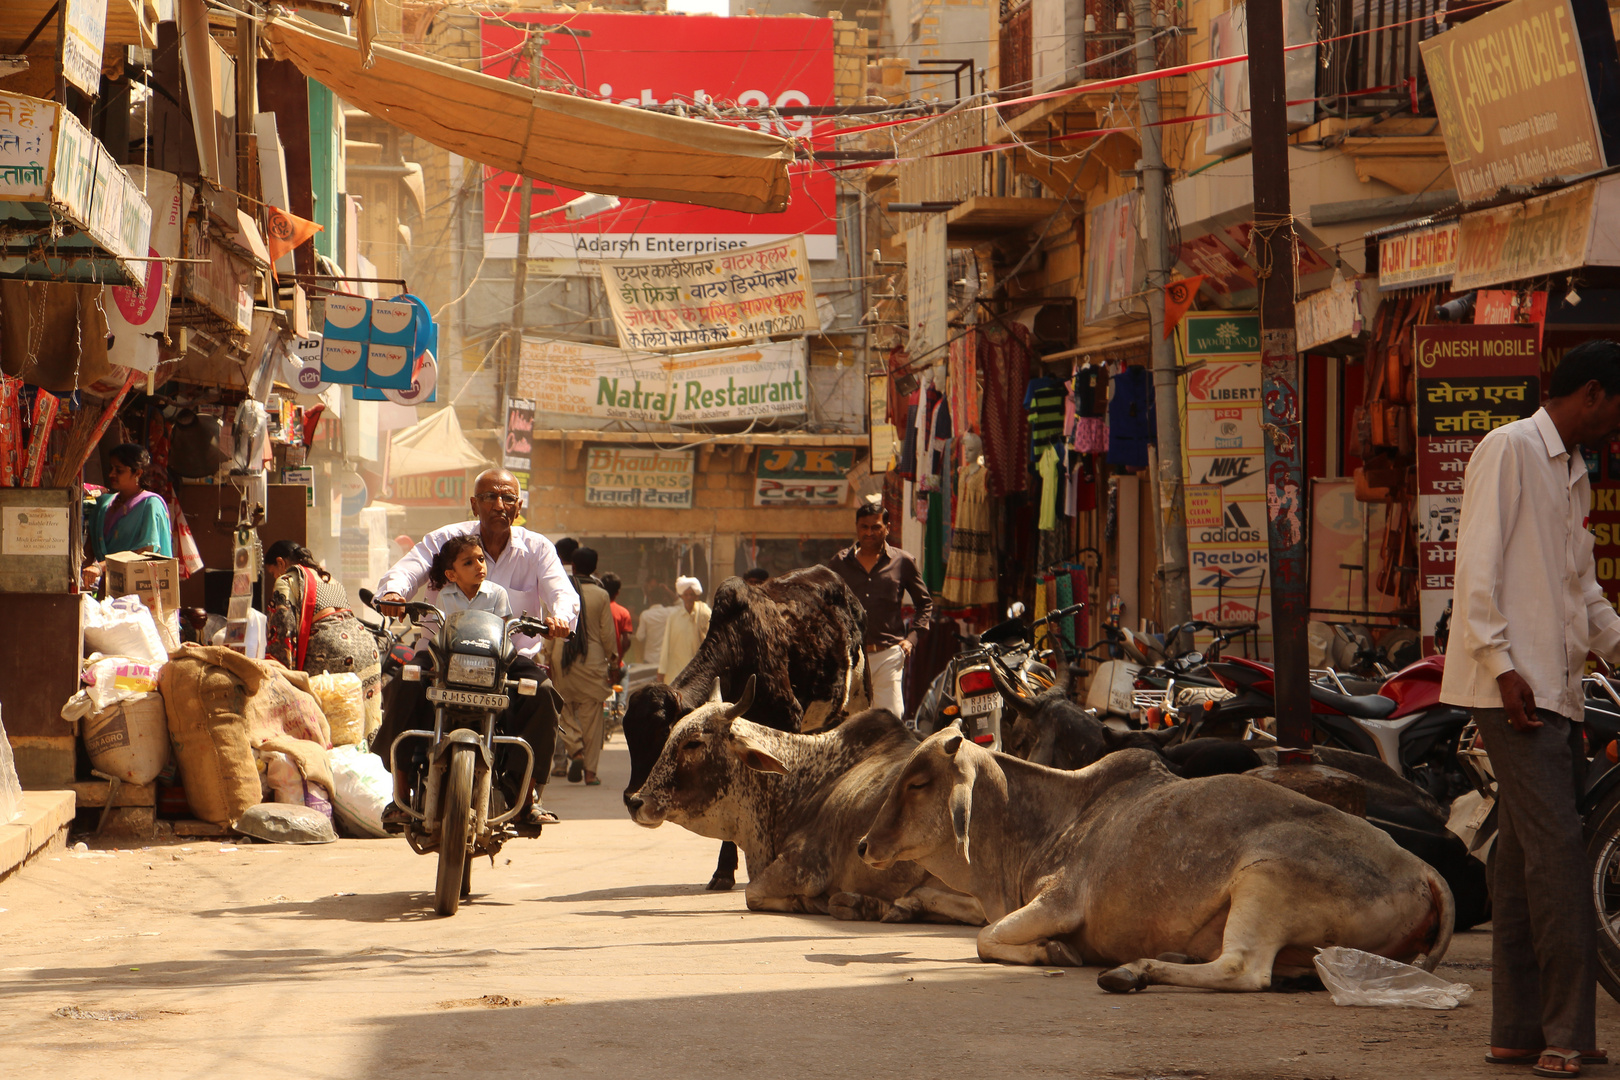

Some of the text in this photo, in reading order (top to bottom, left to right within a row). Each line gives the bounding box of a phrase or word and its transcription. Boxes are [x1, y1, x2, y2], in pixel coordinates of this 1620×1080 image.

[1509, 6, 1577, 92] MOBILE
[168, 195, 181, 226] airtel
[577, 237, 748, 255] Adarsh Enterprises
[1381, 239, 1407, 274] AJAY
[1410, 230, 1449, 267] LEATHER
[720, 253, 755, 271] वाटर
[756, 245, 789, 270] कूलर
[690, 281, 728, 299] वाटर
[298, 340, 320, 349] HD
[1197, 336, 1258, 350] WOODLAND
[1419, 339, 1535, 368] GANESH MOBILE
[300, 373, 320, 383] d2h
[597, 369, 804, 421] Natraj Restaurant
[1210, 388, 1262, 400] LIBERT
[1427, 381, 1528, 404] सेल एवं
[1216, 409, 1241, 418] RED
[1209, 457, 1251, 477] NIKE
[396, 476, 433, 498] HAIR
[435, 476, 465, 498] CUT
[602, 473, 679, 488] TAILORS
[758, 479, 843, 498] टेलर
[1185, 517, 1220, 525] AISALMER
[1189, 508, 1212, 516] CLEAN
[1201, 527, 1261, 542] adidas
[1193, 551, 1268, 567] Reebok
